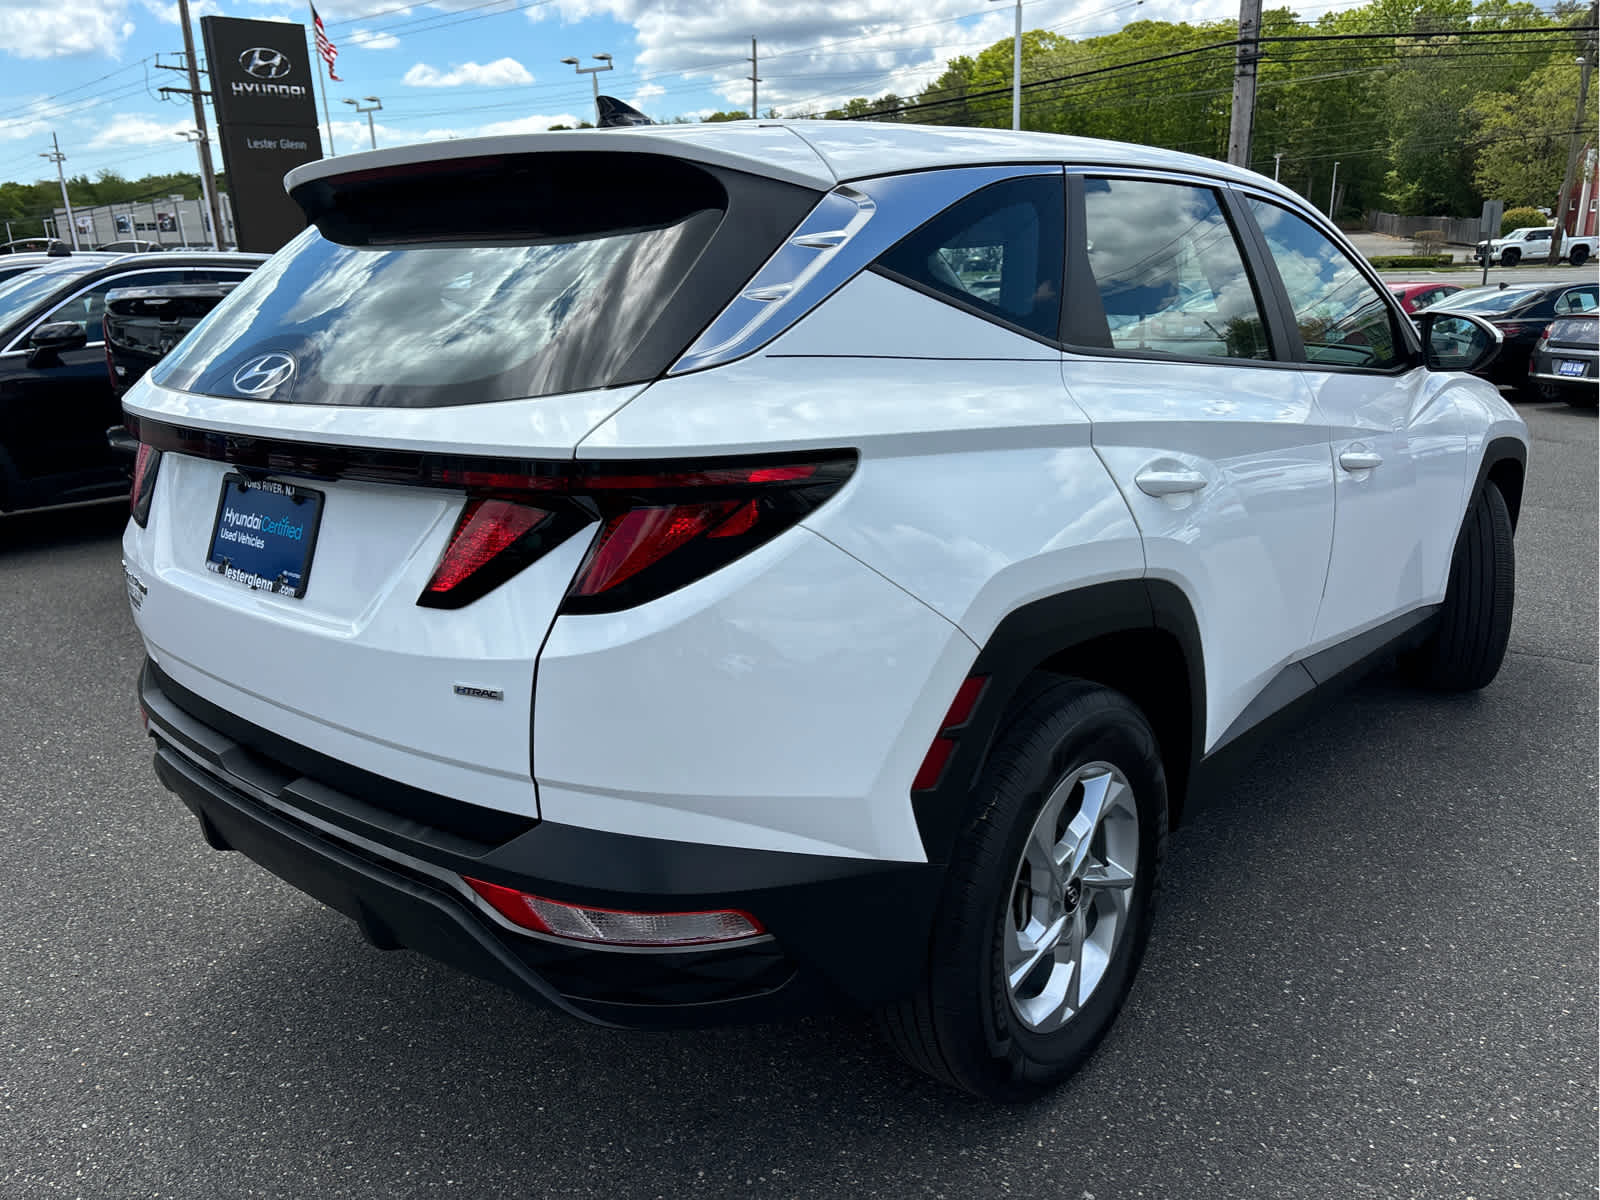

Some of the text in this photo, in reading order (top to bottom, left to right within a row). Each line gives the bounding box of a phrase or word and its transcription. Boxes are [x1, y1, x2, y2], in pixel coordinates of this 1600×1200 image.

[231, 82, 306, 96] HYUNDAI
[247, 138, 308, 151] Lester Glenn
[285, 485, 295, 495] NJ
[220, 528, 265, 549] Used Vehicles
[454, 686, 498, 699] HTRAC
